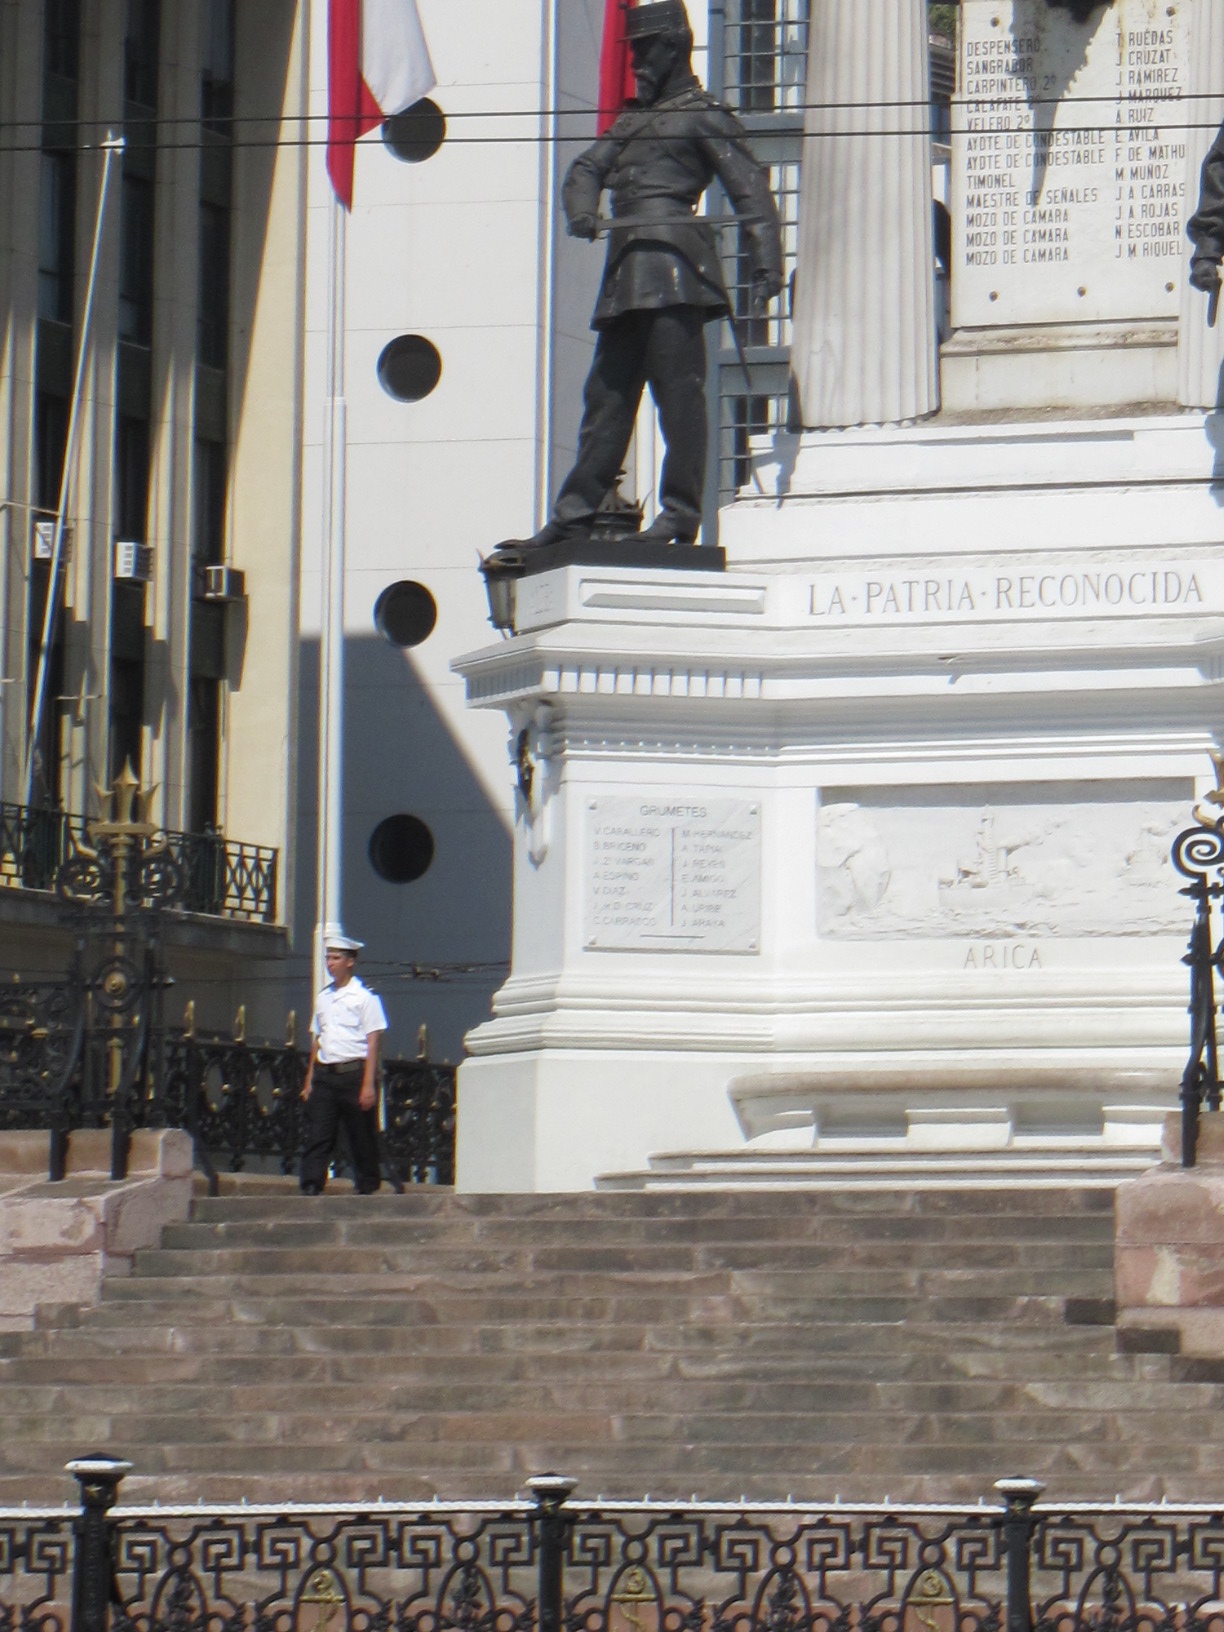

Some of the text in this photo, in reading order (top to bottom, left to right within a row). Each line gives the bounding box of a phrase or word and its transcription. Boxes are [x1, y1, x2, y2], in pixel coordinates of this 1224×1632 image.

[967, 38, 1041, 56] DESPENSERO
[1116, 49, 1172, 66] J CRUZAT
[966, 58, 1034, 76] SANGRADOR
[966, 76, 1036, 94] CARPINTERO
[1116, 68, 1178, 86] J RAMIREZ
[1128, 86, 1182, 104] MARQUEZ
[1116, 108, 1154, 124] A RUIZ
[1006, 134, 1020, 148] DE
[1026, 131, 1105, 148] CONDESTABLE
[1128, 128, 1159, 142] AVILA
[1006, 154, 1020, 168] DE
[1026, 149, 1106, 167] CONDESTABLE
[1116, 148, 1122, 162] F
[1128, 147, 1142, 162] DE
[966, 174, 1016, 189] TIMONEL
[1116, 164, 1169, 182] M MUÑOZ
[966, 188, 1098, 209] MAESTRE DE SEÑALES
[1116, 186, 1122, 200] J
[1128, 186, 1134, 200] A
[966, 208, 1070, 228] MOZO DE CAMARA
[1116, 202, 1178, 220] J A ROJAS
[966, 228, 1069, 248] MOZO DE CAMARA
[1128, 221, 1180, 238] ESCOBAR
[966, 247, 1069, 266] MOZO DE CAMARA
[1116, 244, 1122, 258] J
[808, 570, 1204, 616] LA PATRIA RECONOCIDA
[640, 804, 708, 818] GRUMETES
[963, 944, 1042, 969] ARICA
